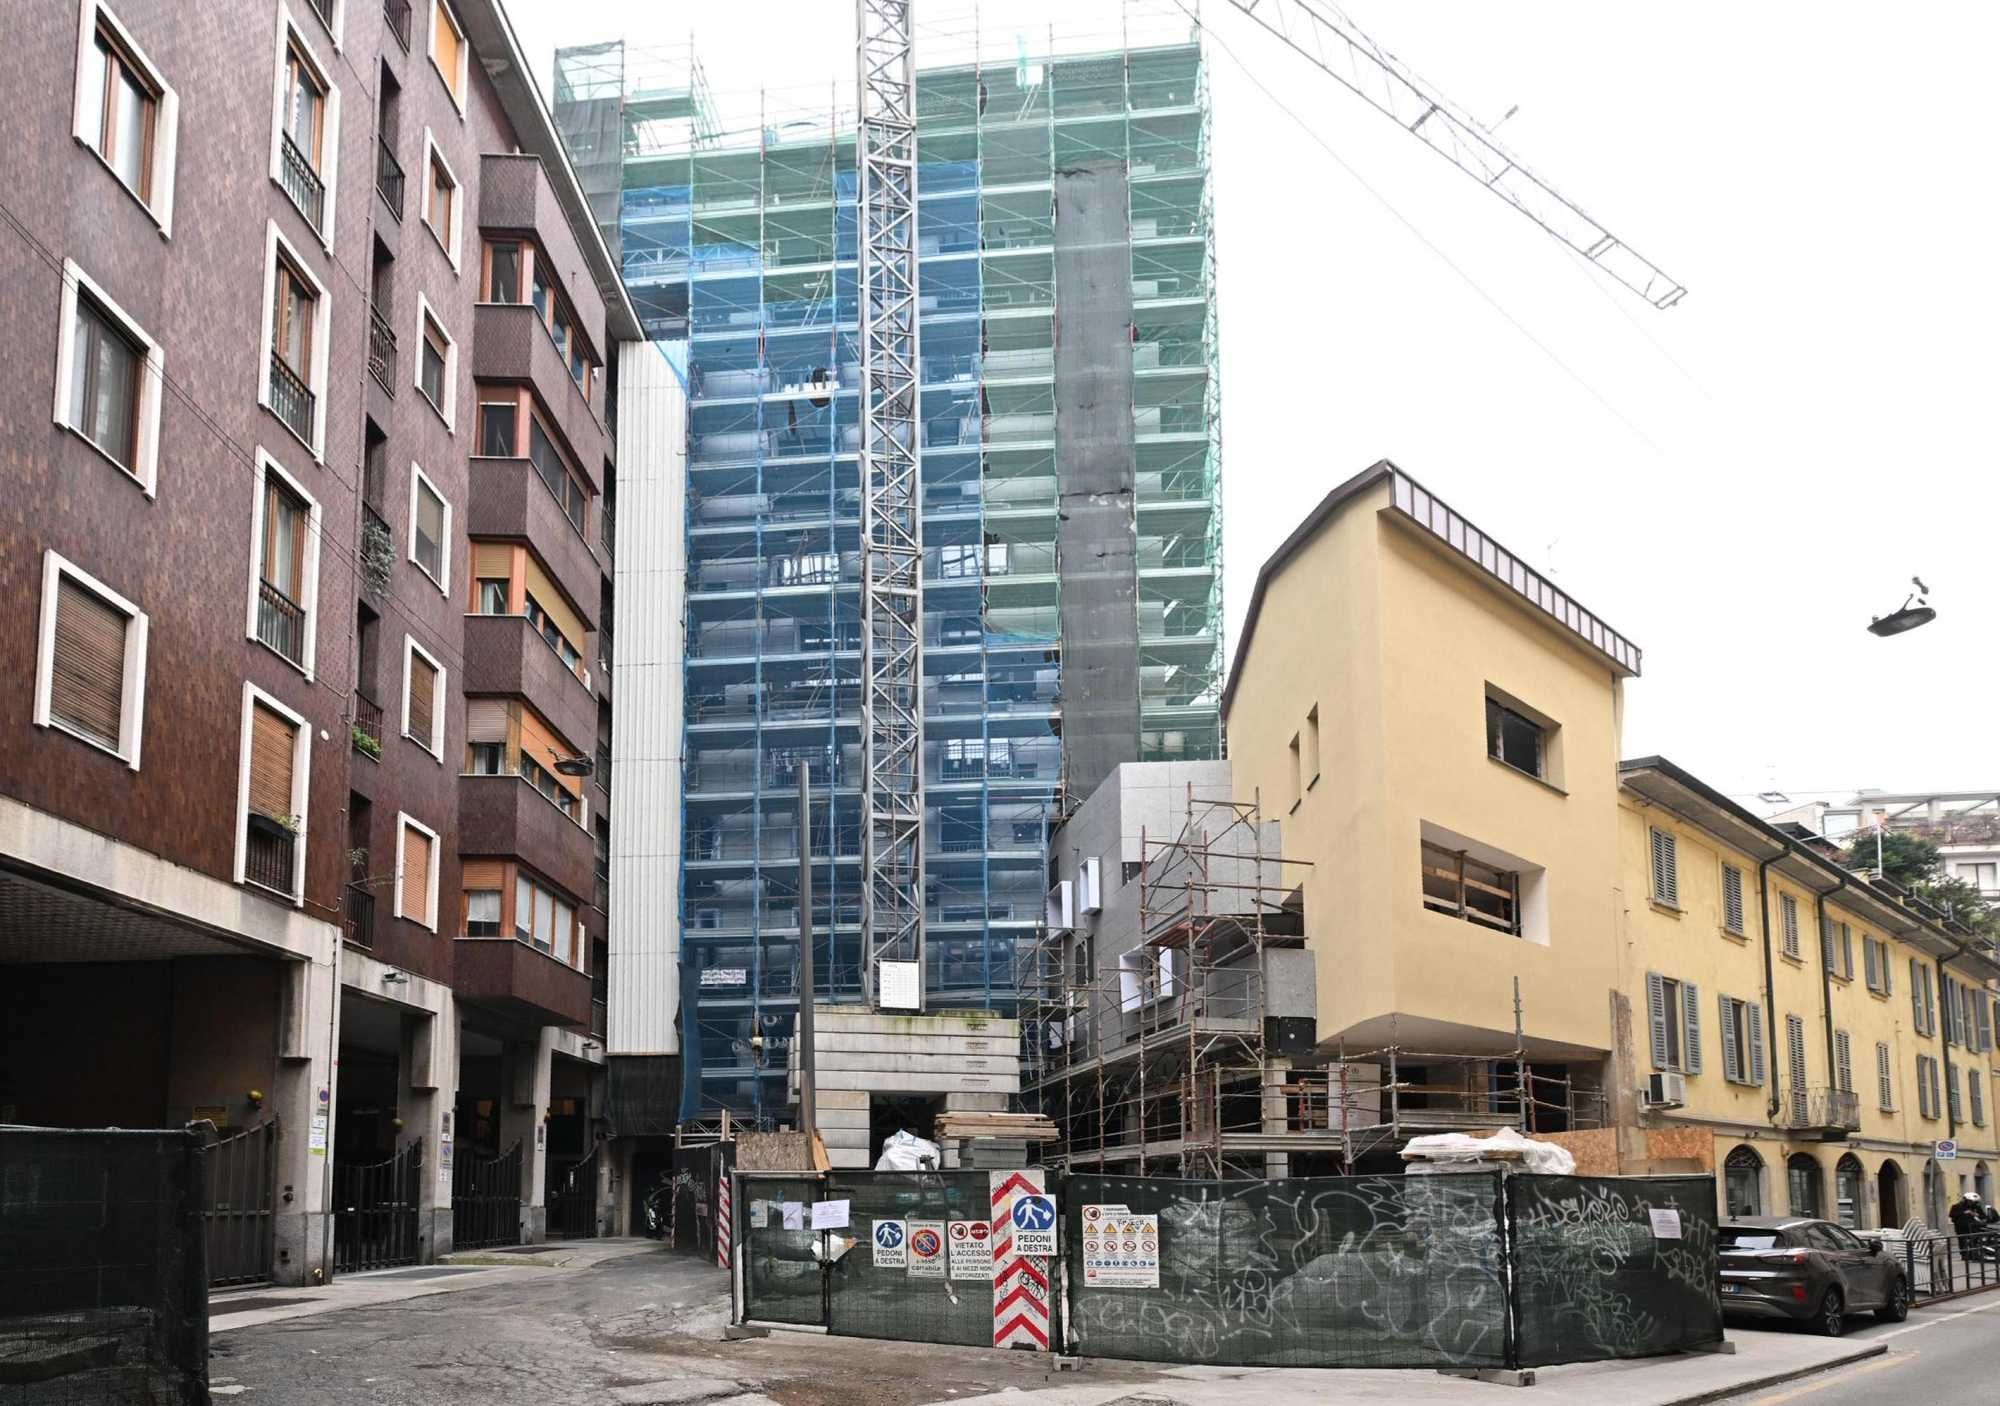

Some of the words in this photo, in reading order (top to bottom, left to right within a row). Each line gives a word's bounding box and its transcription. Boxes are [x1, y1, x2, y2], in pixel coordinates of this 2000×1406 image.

[1018, 1235, 1051, 1243] PEDONI
[1016, 1244, 1022, 1252] A
[1023, 1244, 1053, 1252] DESTRA
[877, 1249, 902, 1257] PEDONI
